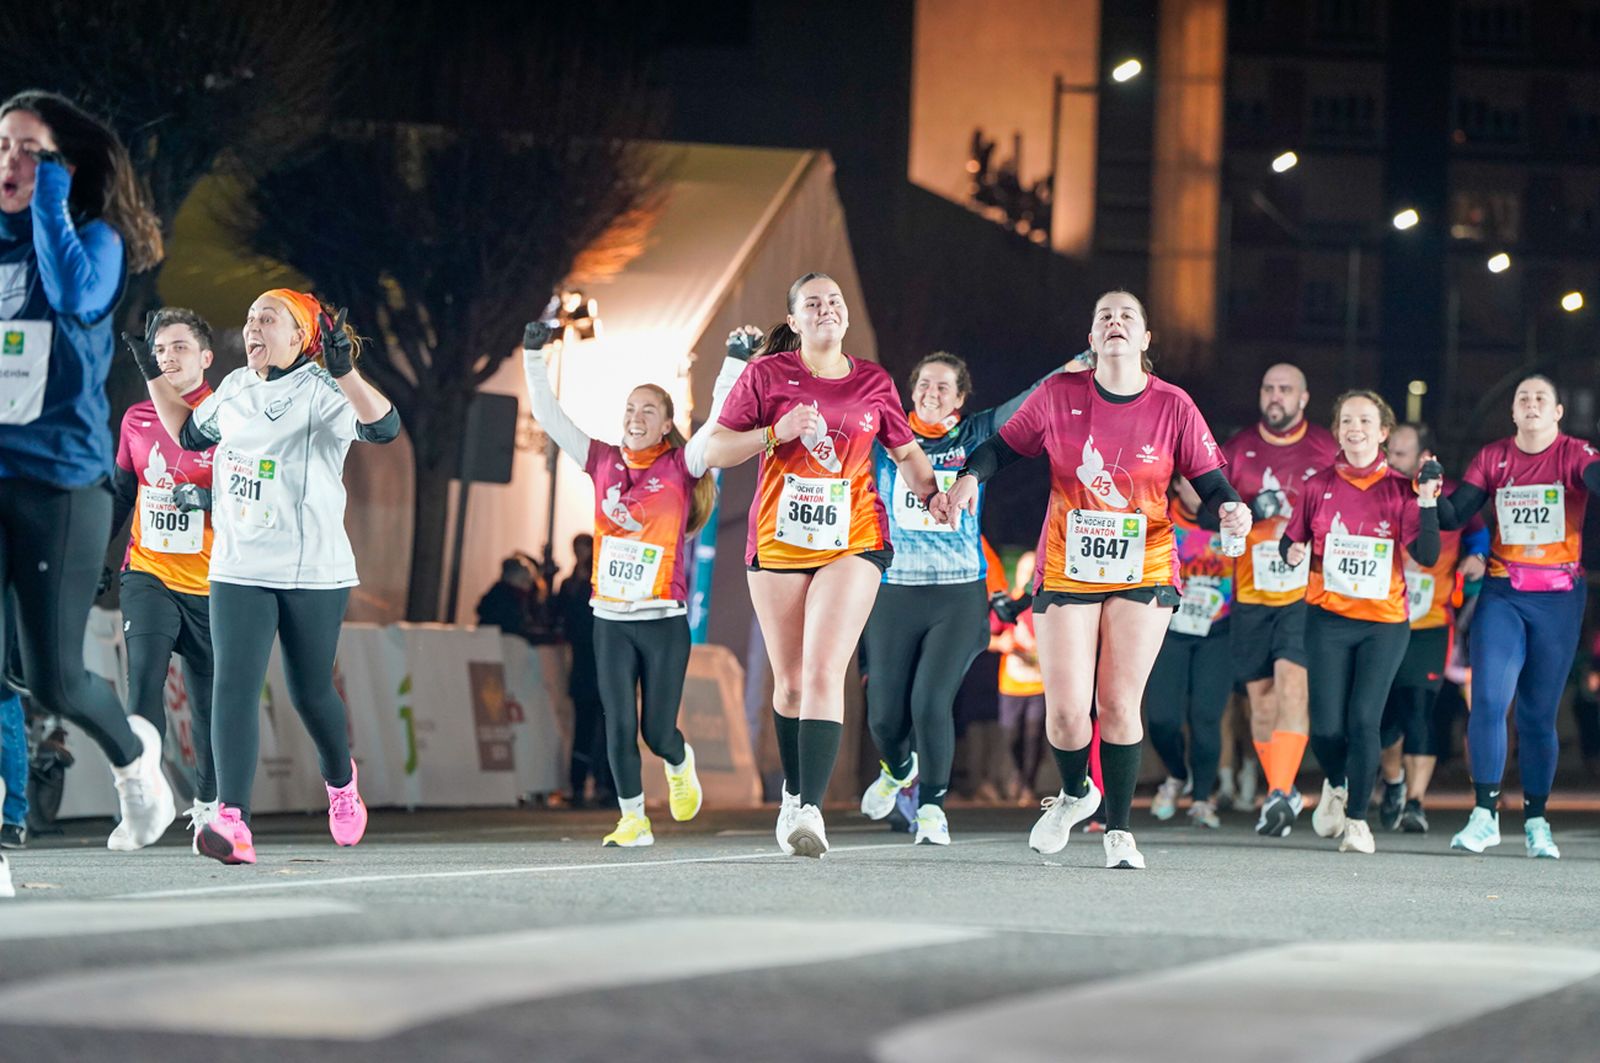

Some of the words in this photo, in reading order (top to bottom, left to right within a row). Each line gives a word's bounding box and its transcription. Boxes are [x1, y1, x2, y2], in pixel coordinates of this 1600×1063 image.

[813, 442, 832, 460] 43
[927, 446, 966, 466] NTÓN
[228, 473, 262, 501] 2311
[1091, 476, 1112, 496] 43
[149, 510, 190, 532] 7609
[611, 507, 627, 524] 43
[788, 500, 837, 526] 3646
[1083, 518, 1106, 527] NOCHE
[1107, 519, 1116, 528] DE
[1512, 506, 1550, 524] 2212
[1074, 525, 1089, 534] SAN
[1081, 535, 1129, 560] 3647
[609, 560, 644, 581] 6739
[1338, 557, 1377, 577] 4512
